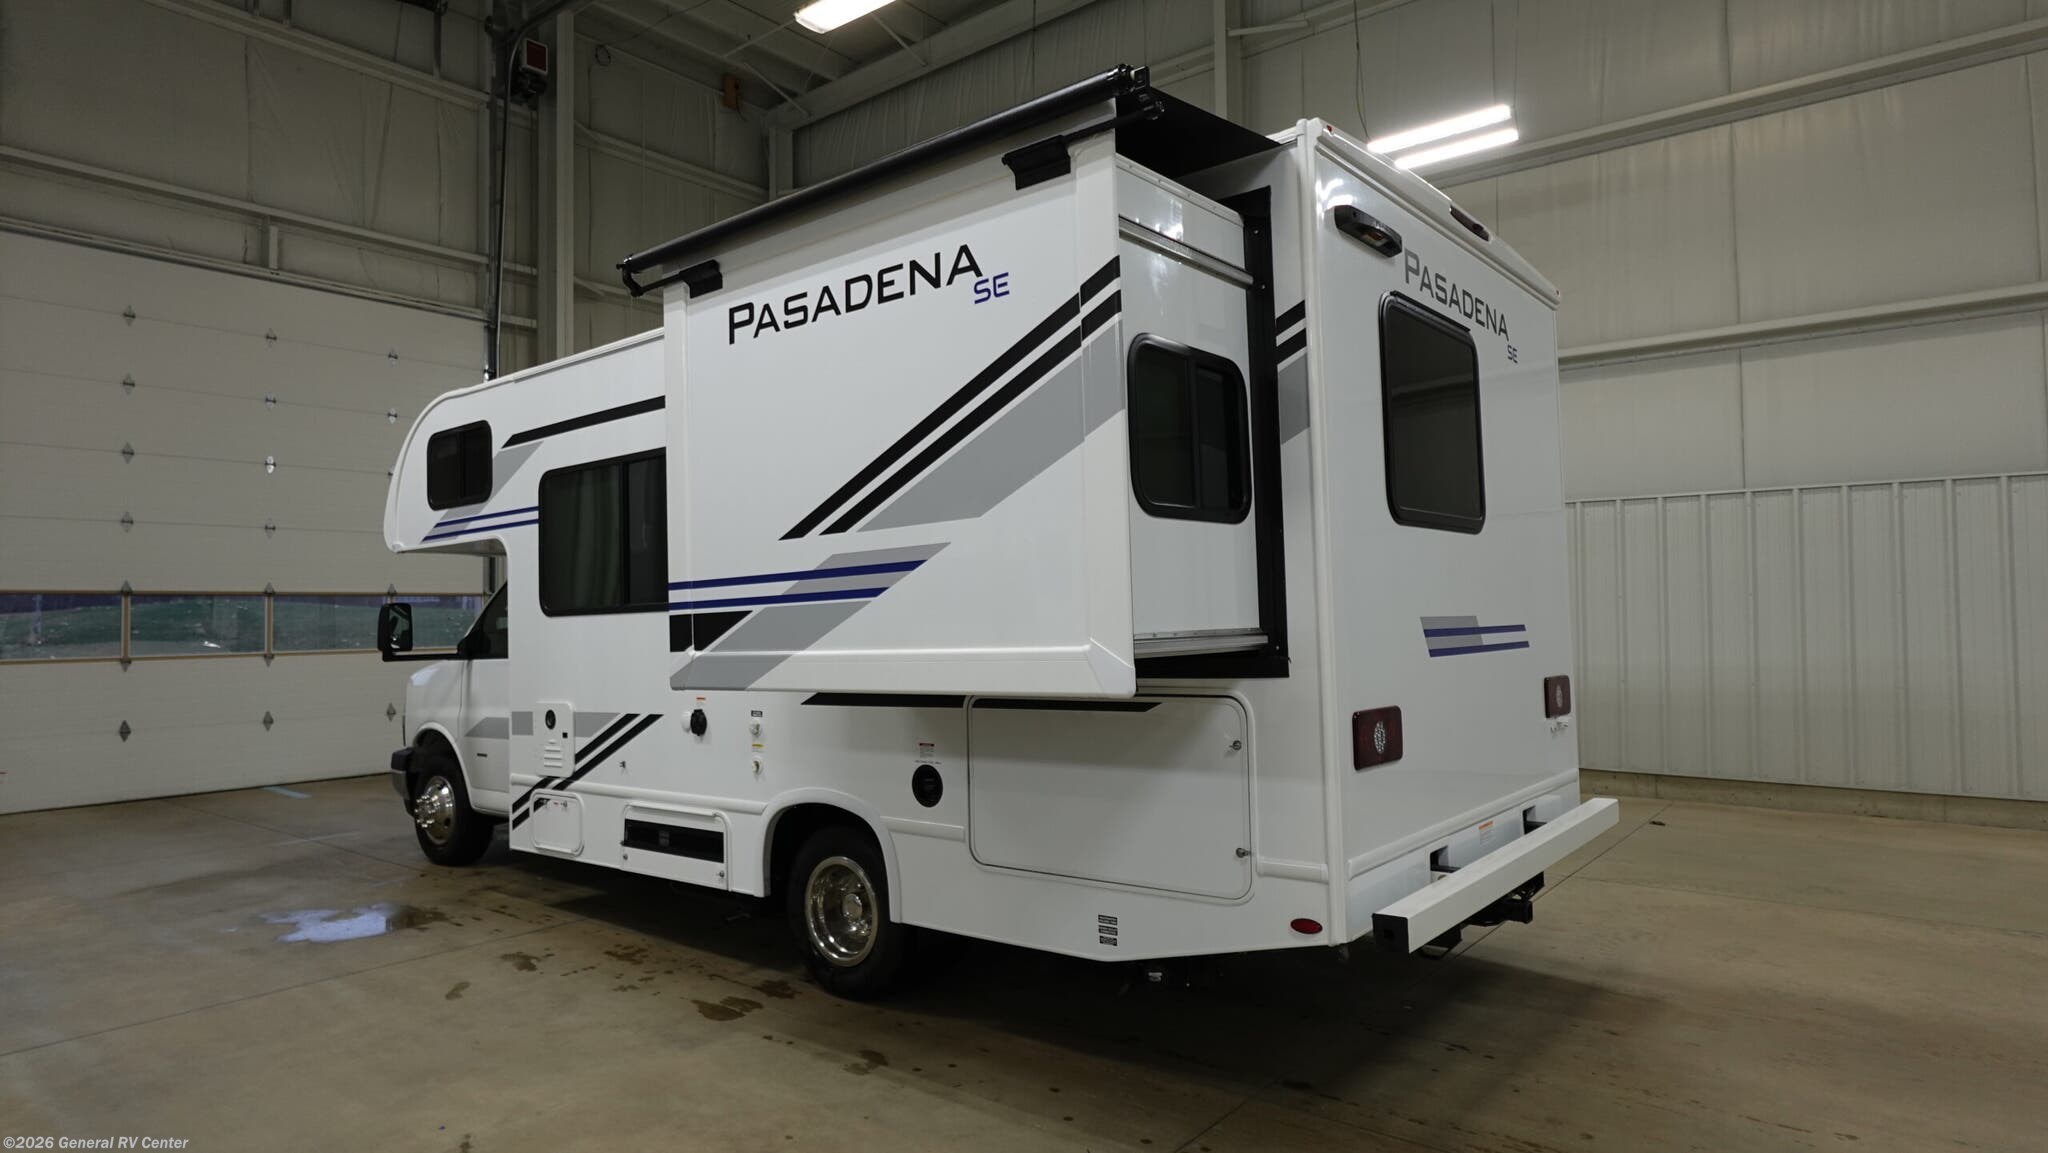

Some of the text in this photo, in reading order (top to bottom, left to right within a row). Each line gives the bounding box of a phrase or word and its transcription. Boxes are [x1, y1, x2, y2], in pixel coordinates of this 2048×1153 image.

[728, 244, 1010, 345] PASADENA SE
[1404, 247, 1518, 364] PASADENA SE
